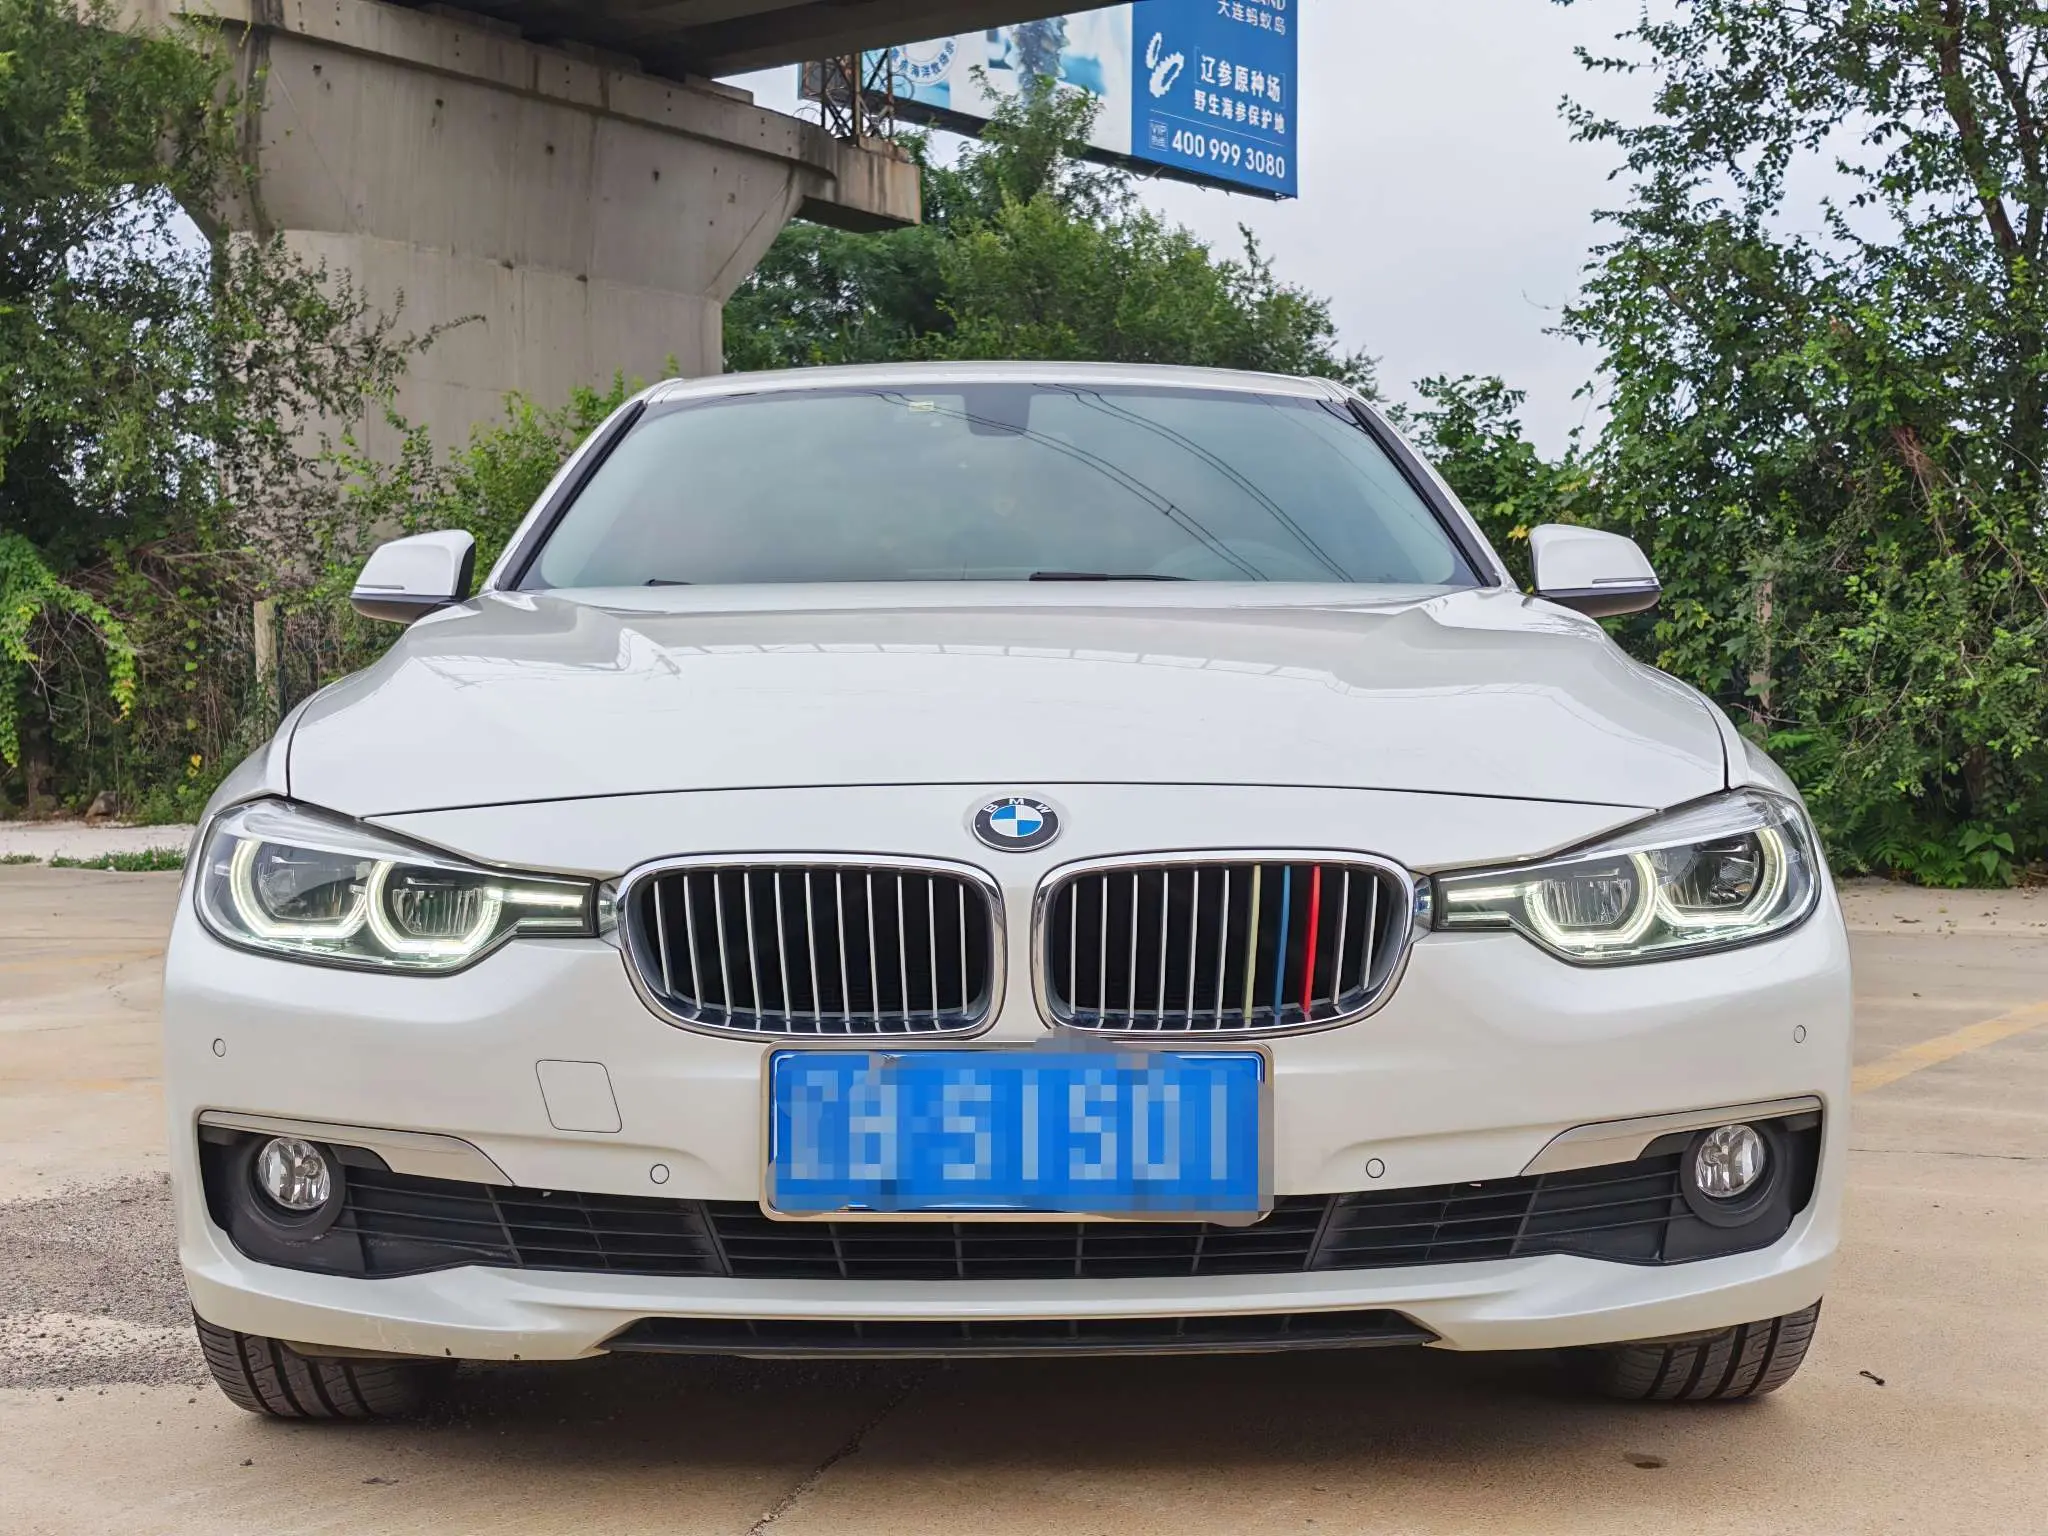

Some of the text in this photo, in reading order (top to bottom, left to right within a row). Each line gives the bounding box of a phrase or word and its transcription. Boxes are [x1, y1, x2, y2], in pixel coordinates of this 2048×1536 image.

[1217, 0, 1286, 36] 大连蚂蚁岛
[1200, 55, 1281, 103] 辽参原种场
[1194, 89, 1285, 134] 野生海参保护地
[1171, 130, 1285, 179] 400 999 3080
[983, 798, 1052, 814] BMW
